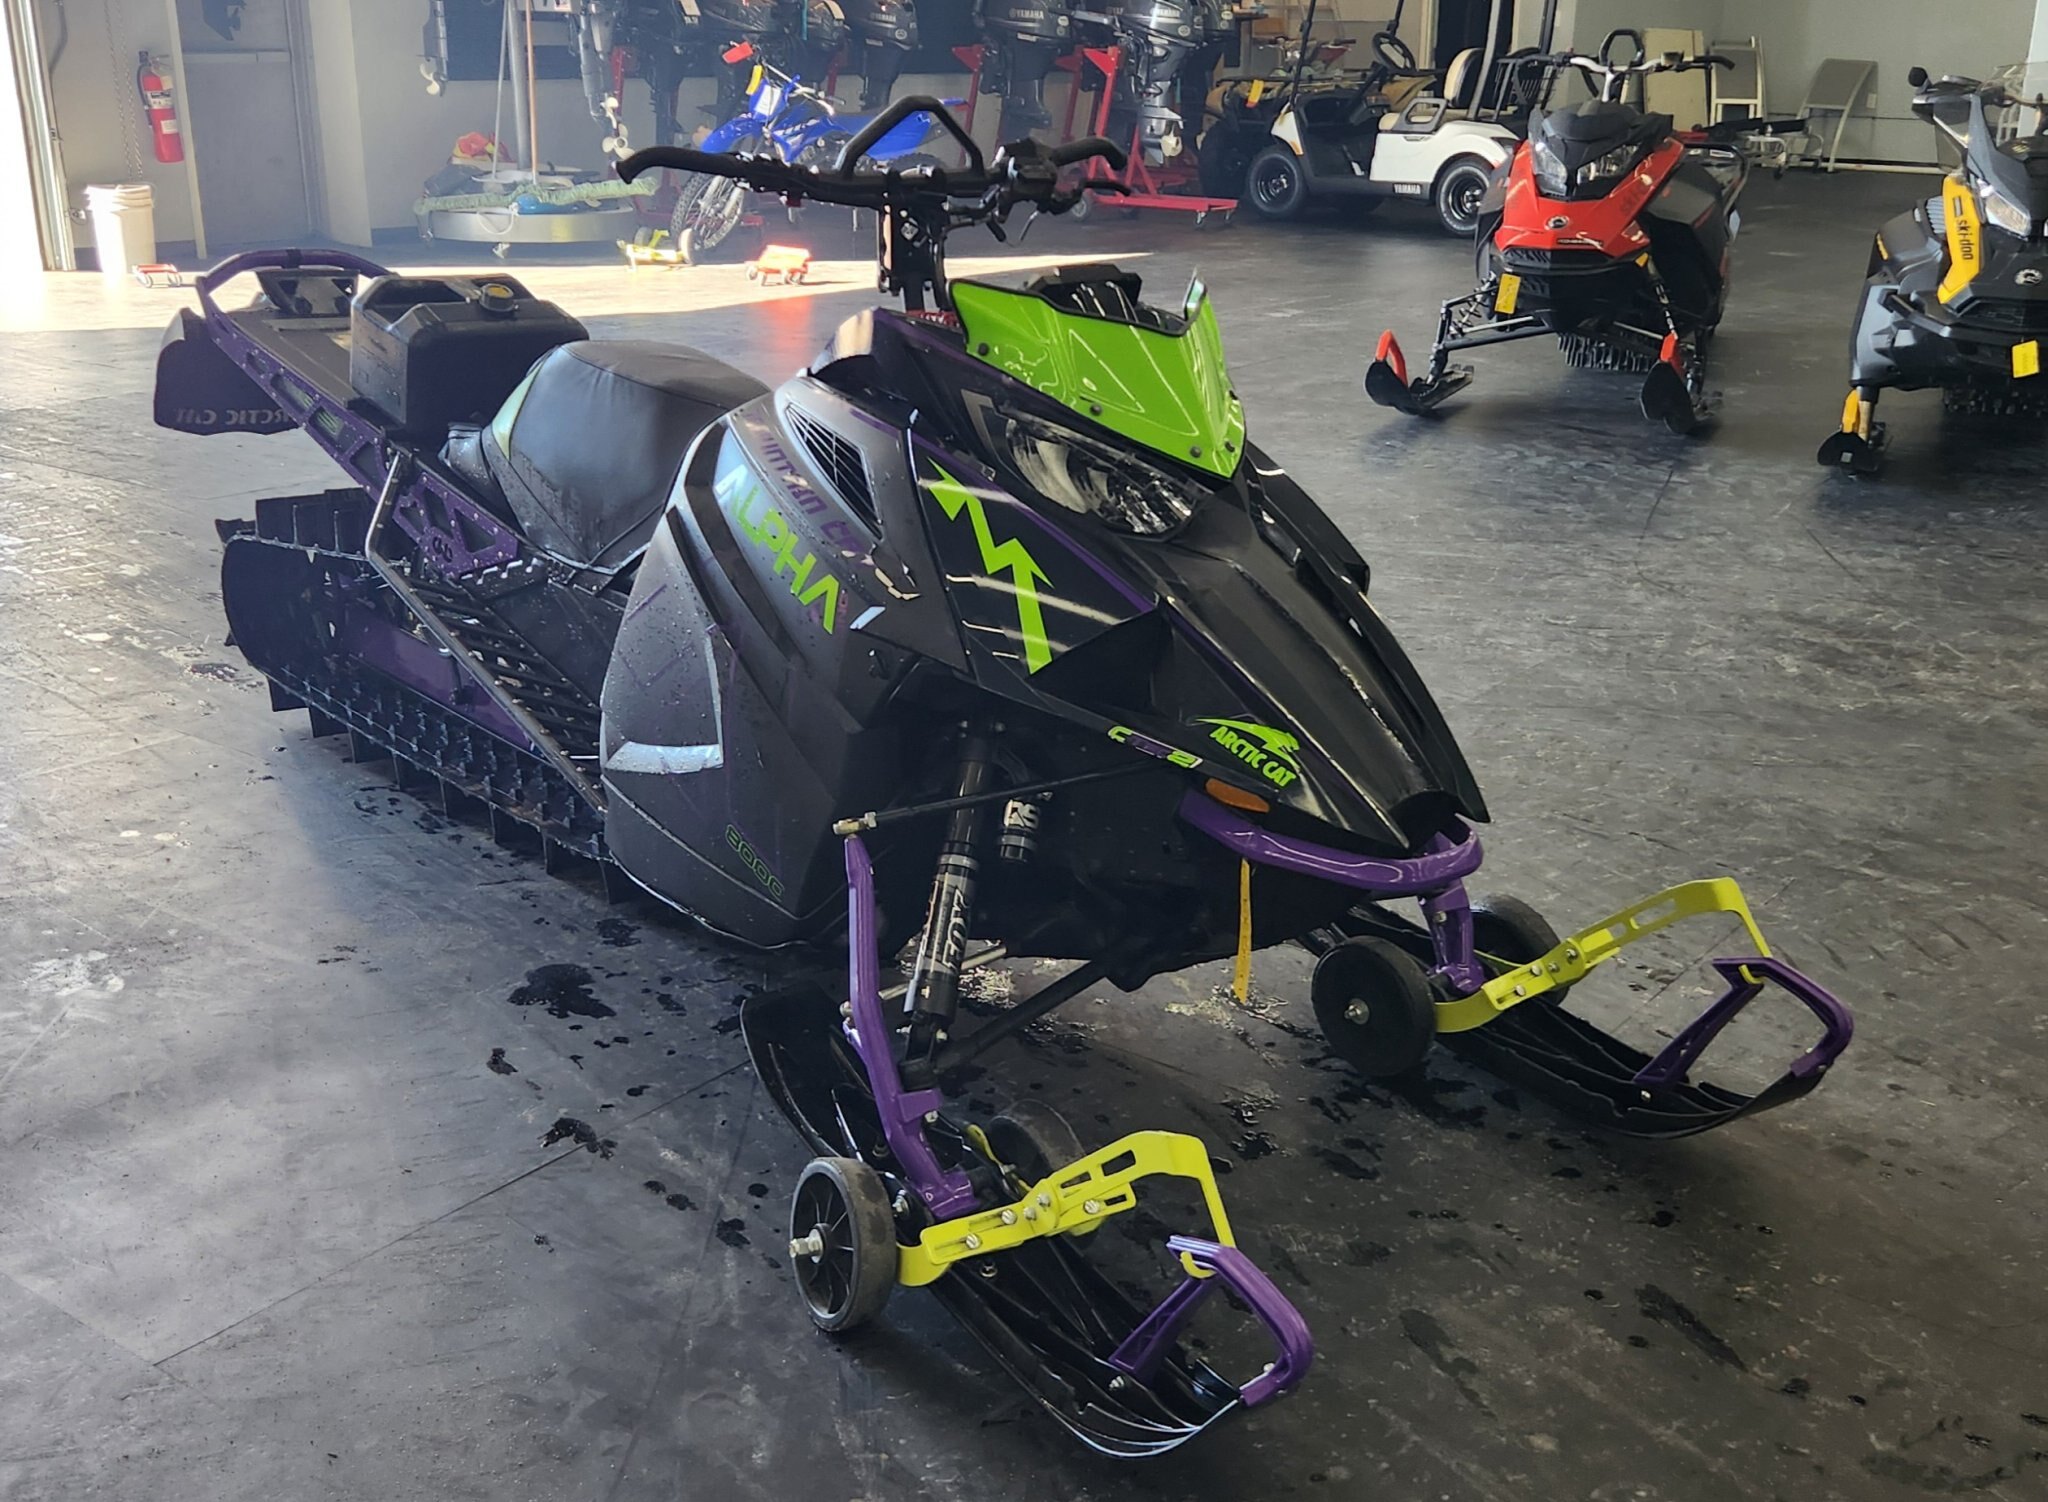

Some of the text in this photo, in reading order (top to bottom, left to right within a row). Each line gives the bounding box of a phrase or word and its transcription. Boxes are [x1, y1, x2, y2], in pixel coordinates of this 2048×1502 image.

[1957, 219, 1975, 260] ski-doo
[714, 463, 840, 635] ALPHA
[1209, 725, 1268, 769] ARCTIC
[1262, 760, 1297, 787] CAT
